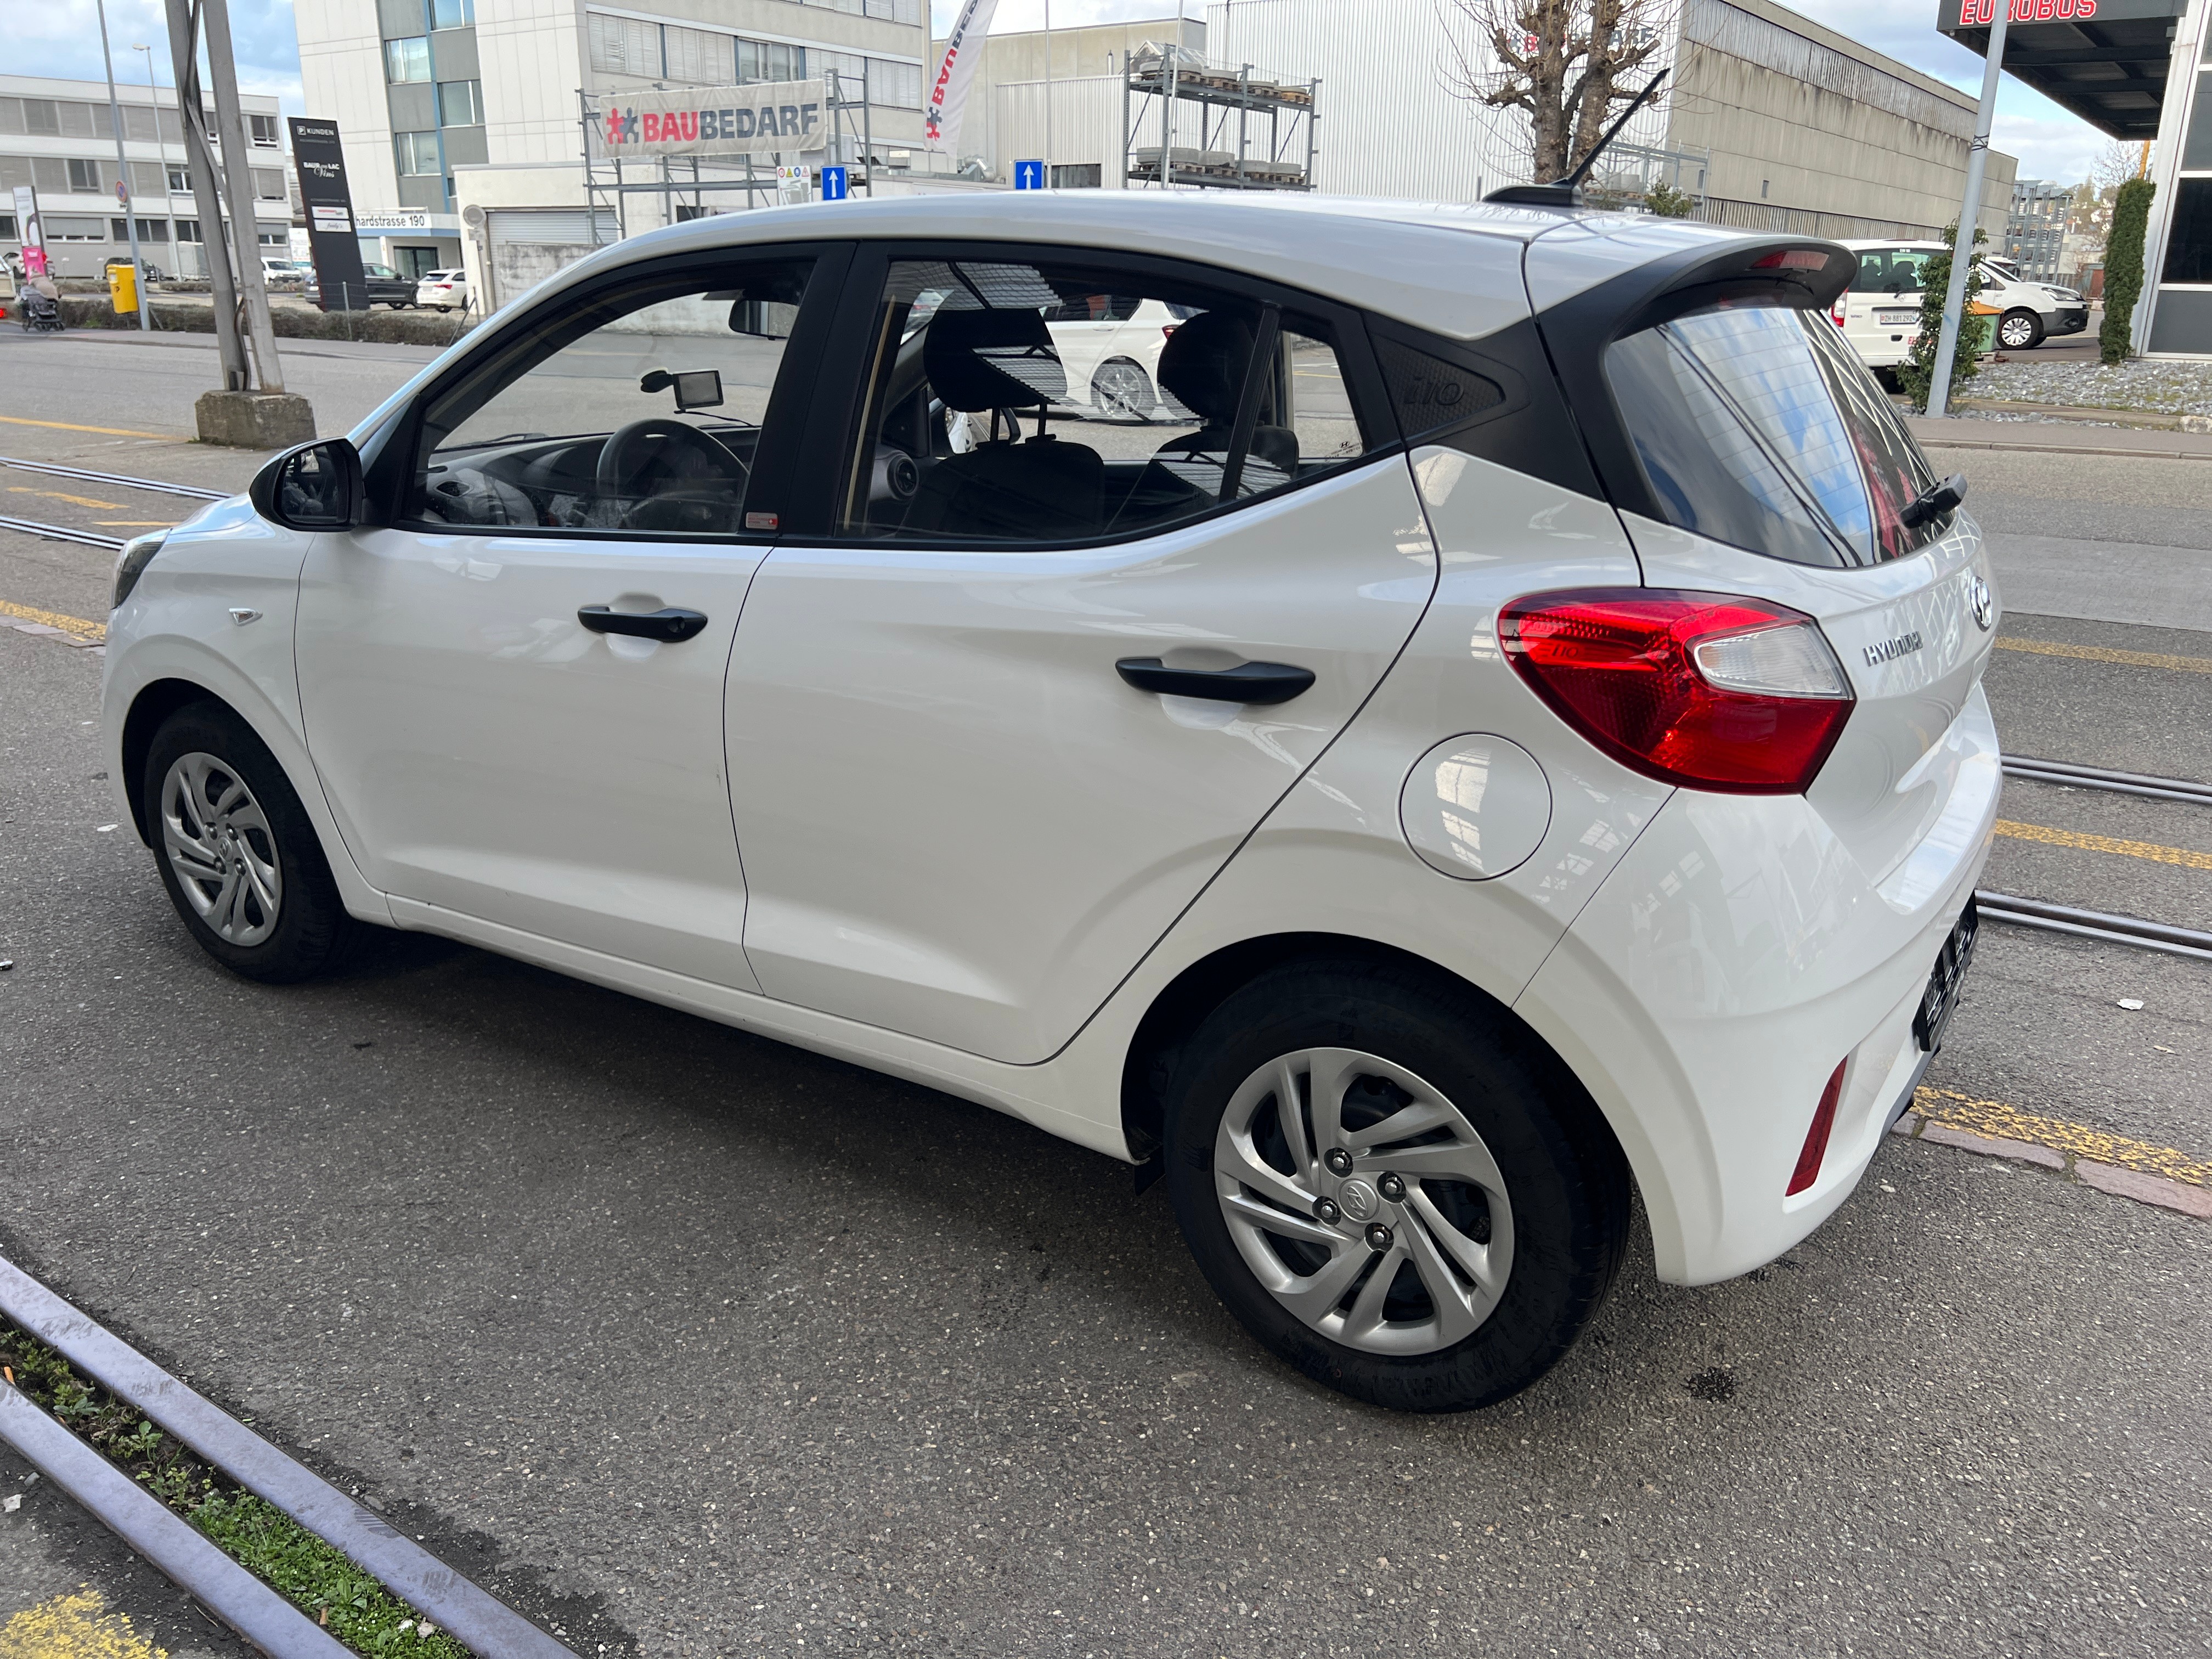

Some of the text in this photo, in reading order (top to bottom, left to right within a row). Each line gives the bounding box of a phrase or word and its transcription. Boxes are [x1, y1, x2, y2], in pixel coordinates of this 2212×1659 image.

[306, 128, 334, 136] KUNDEN
[642, 103, 818, 143] BAUBEDARF
[356, 215, 425, 227] hardstrasse 190
[1864, 631, 1923, 668] HYUNDAI
